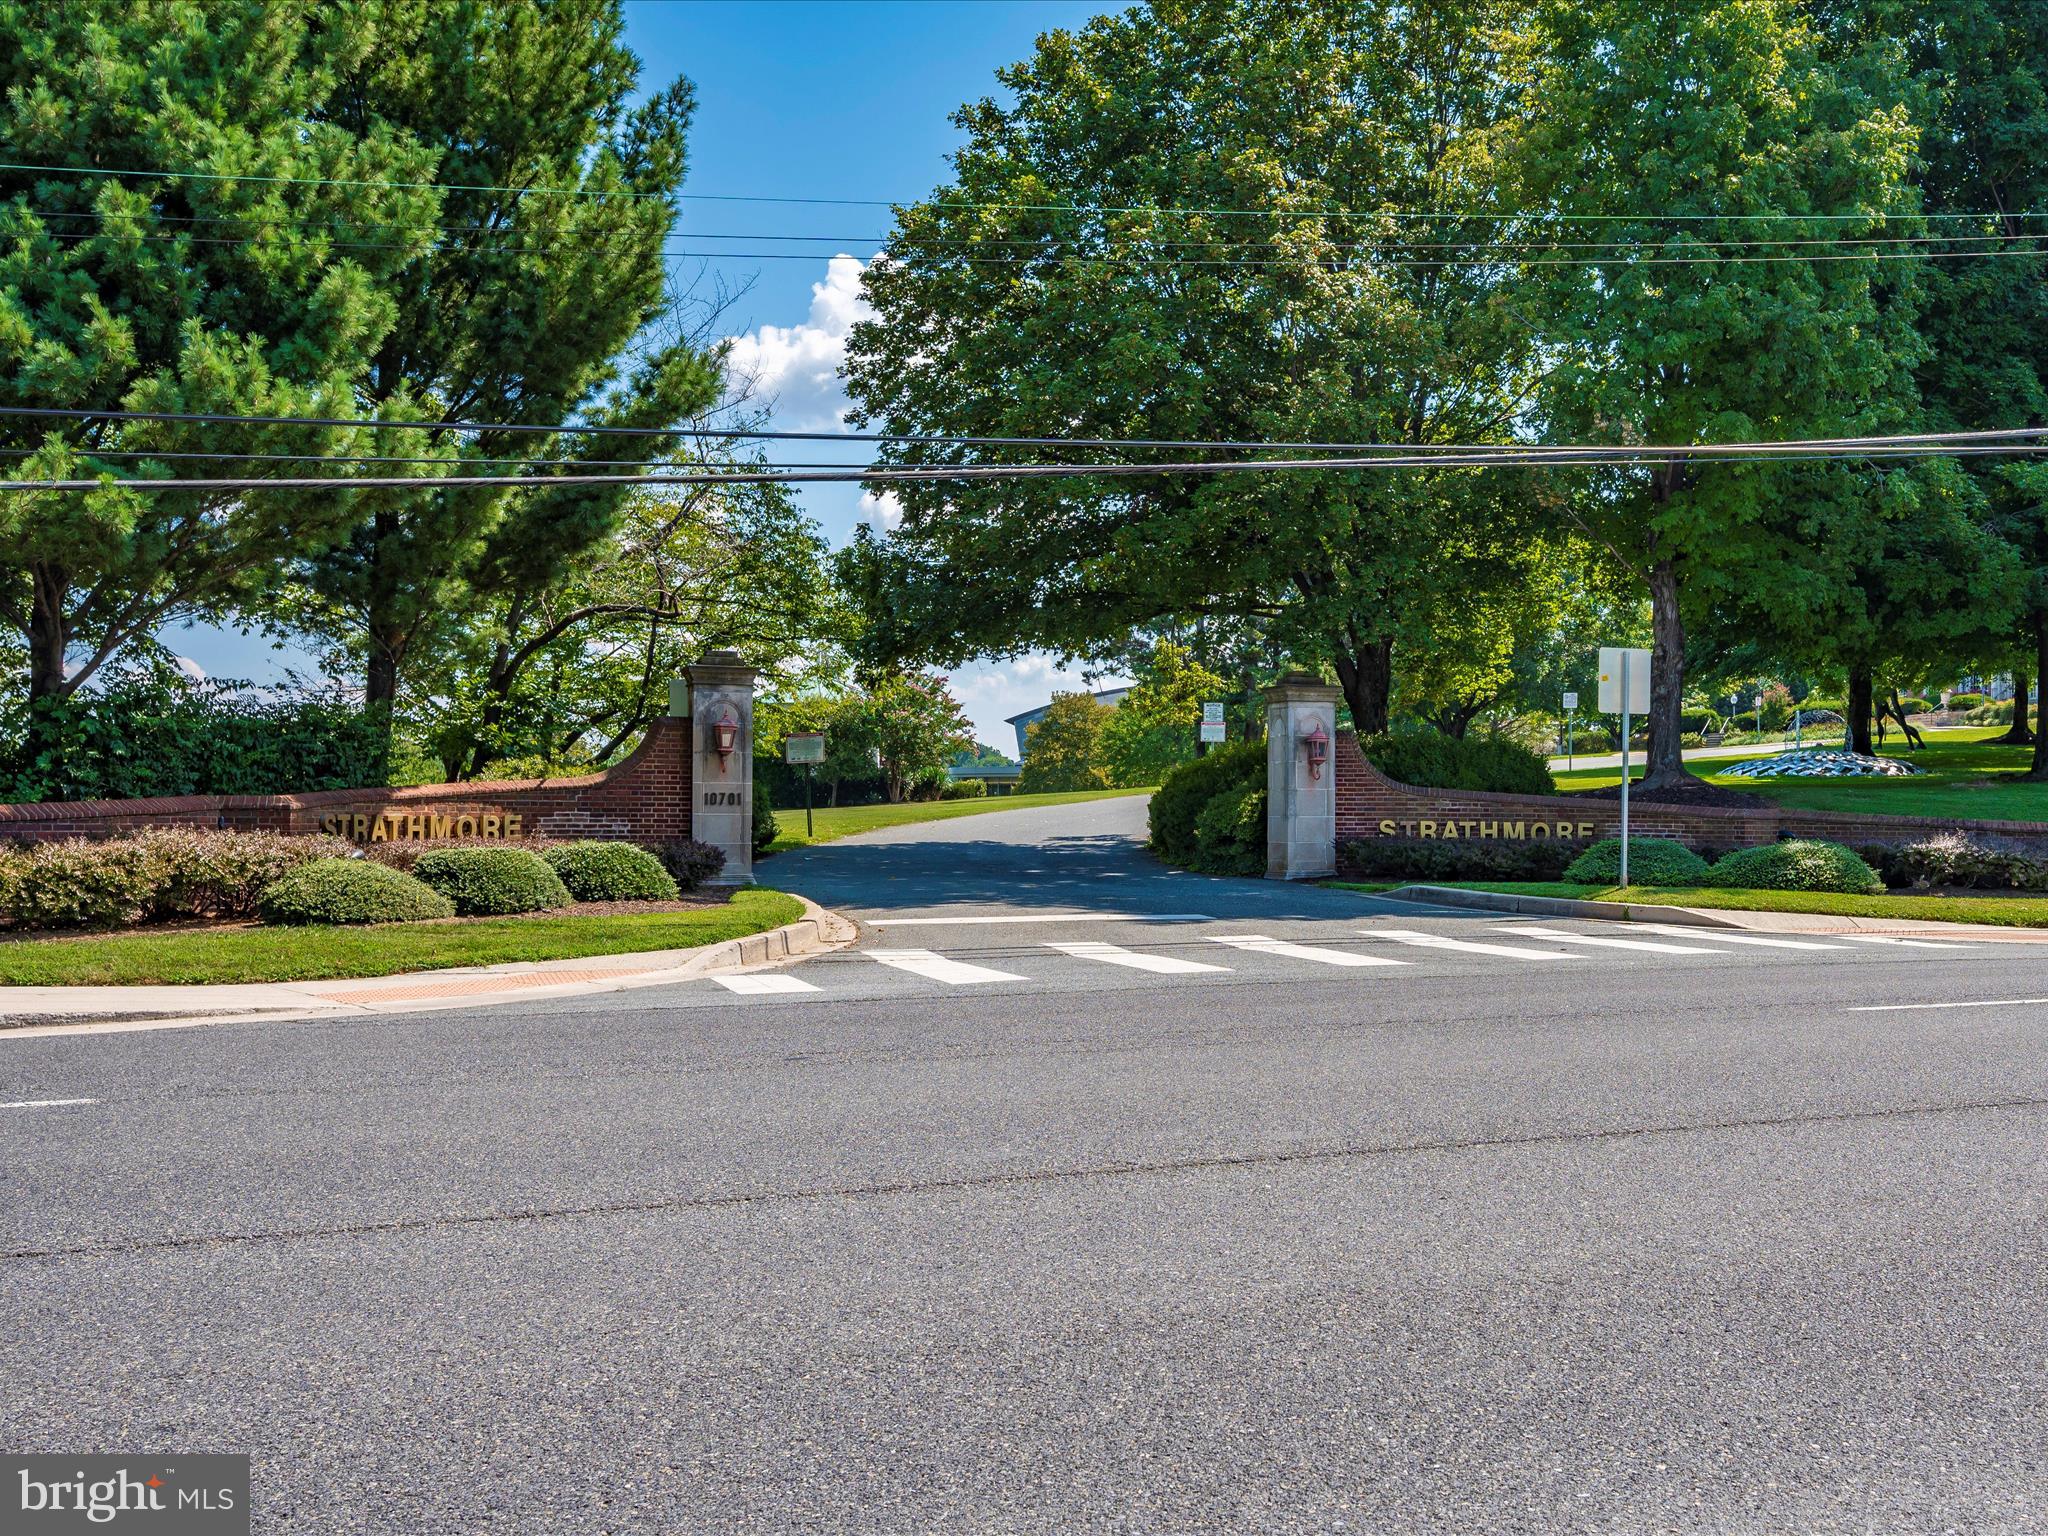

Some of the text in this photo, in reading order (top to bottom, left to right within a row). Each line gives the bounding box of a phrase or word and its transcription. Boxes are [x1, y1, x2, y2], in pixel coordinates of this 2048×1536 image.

[704, 792, 742, 806] 10701
[321, 814, 522, 842] STRATHMORE
[1379, 819, 1595, 840] STRATHMORE
